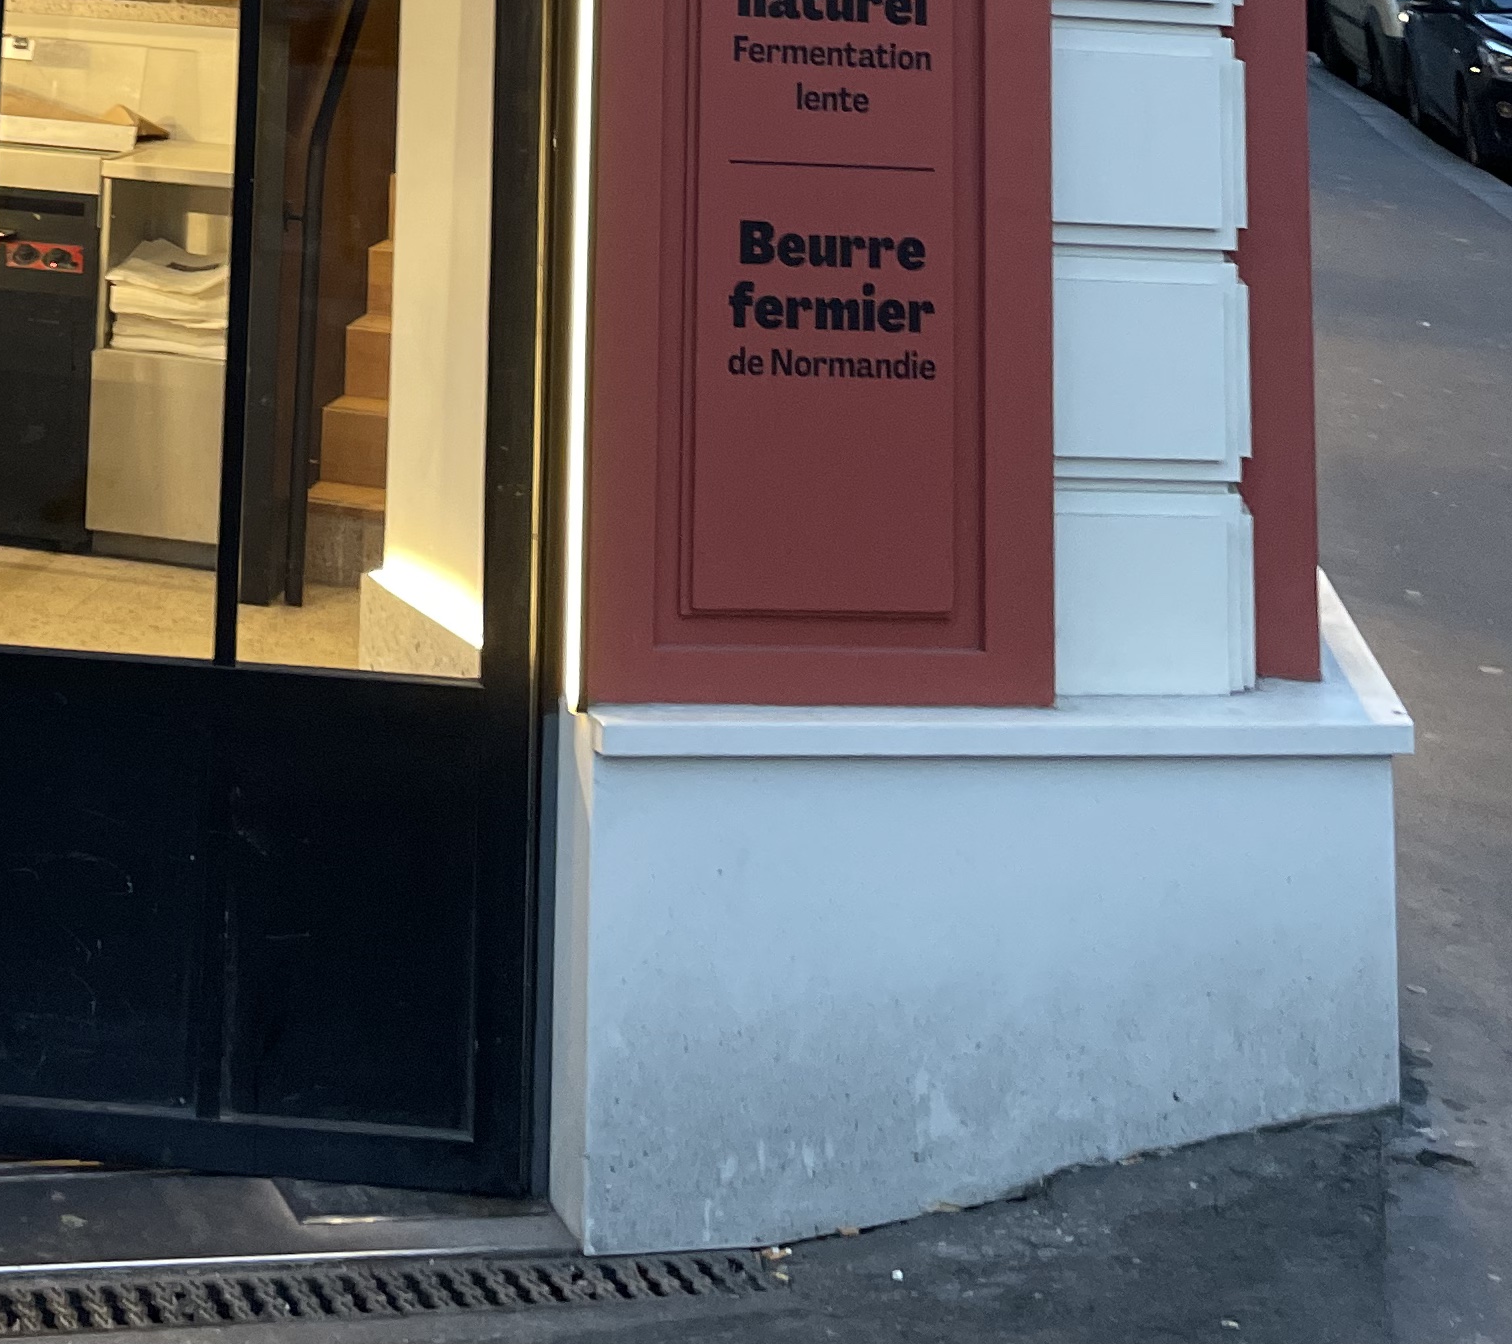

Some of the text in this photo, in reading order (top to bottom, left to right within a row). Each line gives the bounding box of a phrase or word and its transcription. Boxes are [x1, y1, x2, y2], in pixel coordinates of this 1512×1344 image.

[733, 34, 933, 72] Fermentation
[796, 81, 870, 114] lente
[739, 219, 926, 271] Beurre
[728, 280, 936, 334] fermier
[727, 346, 937, 381] de Normandie
